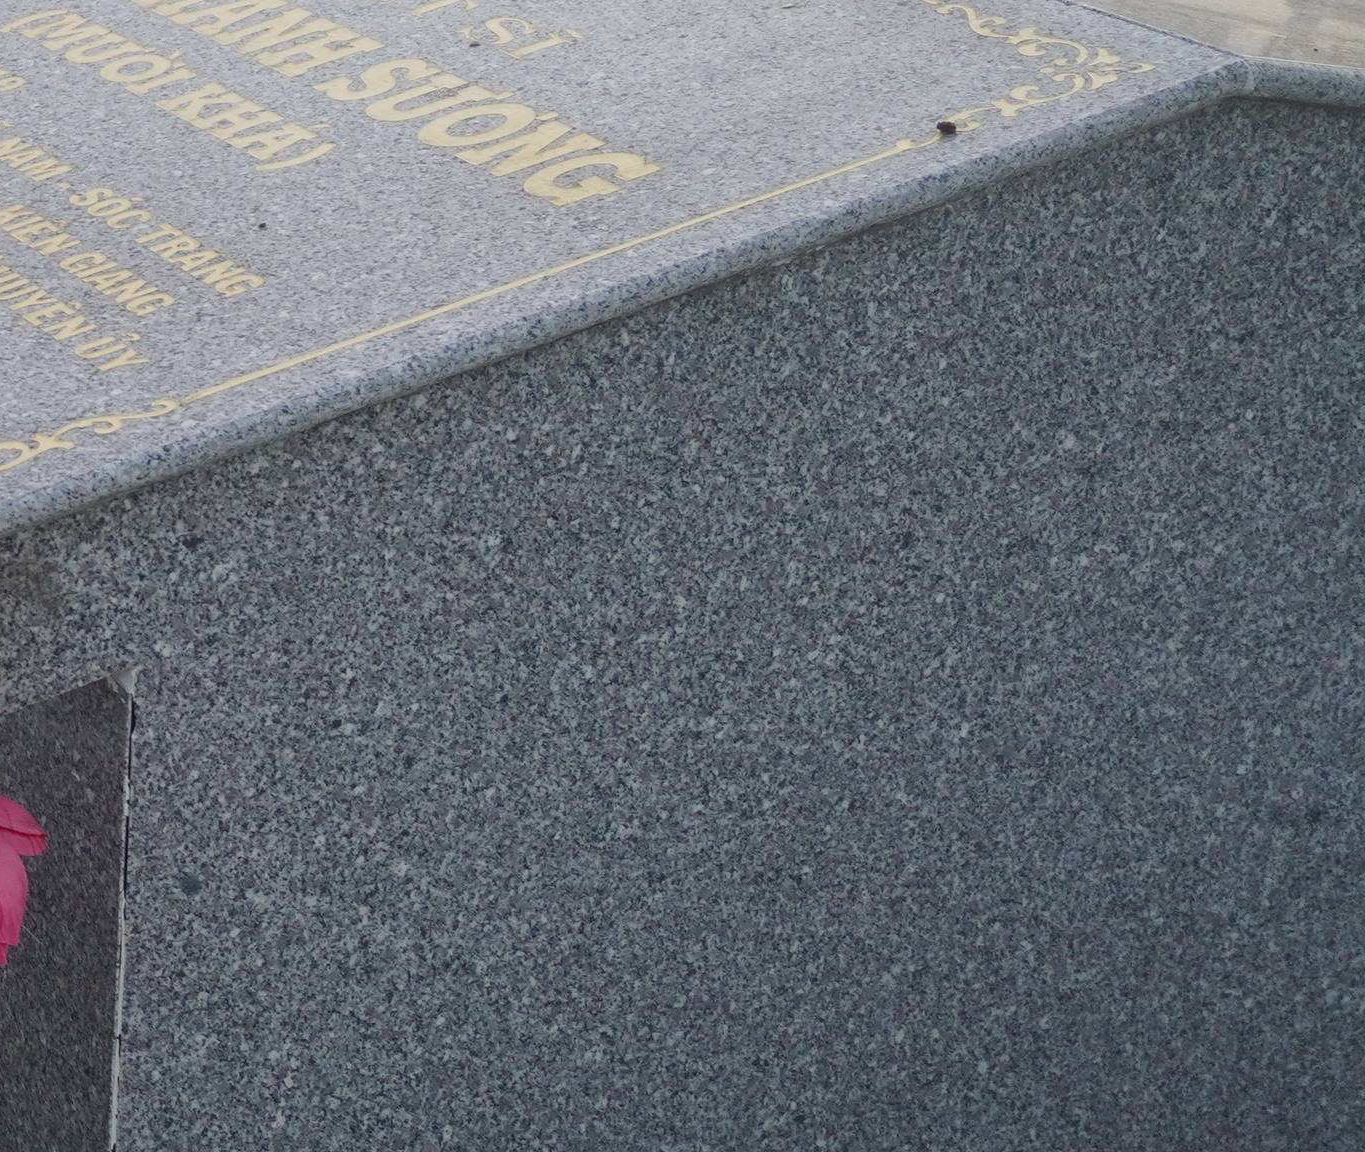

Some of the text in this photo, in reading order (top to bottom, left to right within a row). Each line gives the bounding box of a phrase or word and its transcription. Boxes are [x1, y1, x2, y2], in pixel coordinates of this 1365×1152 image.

[156, 81, 337, 173] KHÁ)
[314, 57, 662, 207] SƯƠNG
[58, 250, 176, 317] GIANG
[69, 186, 154, 231] SÓC
[136, 221, 267, 298] TRANG
[73, 331, 148, 373] ỦY
